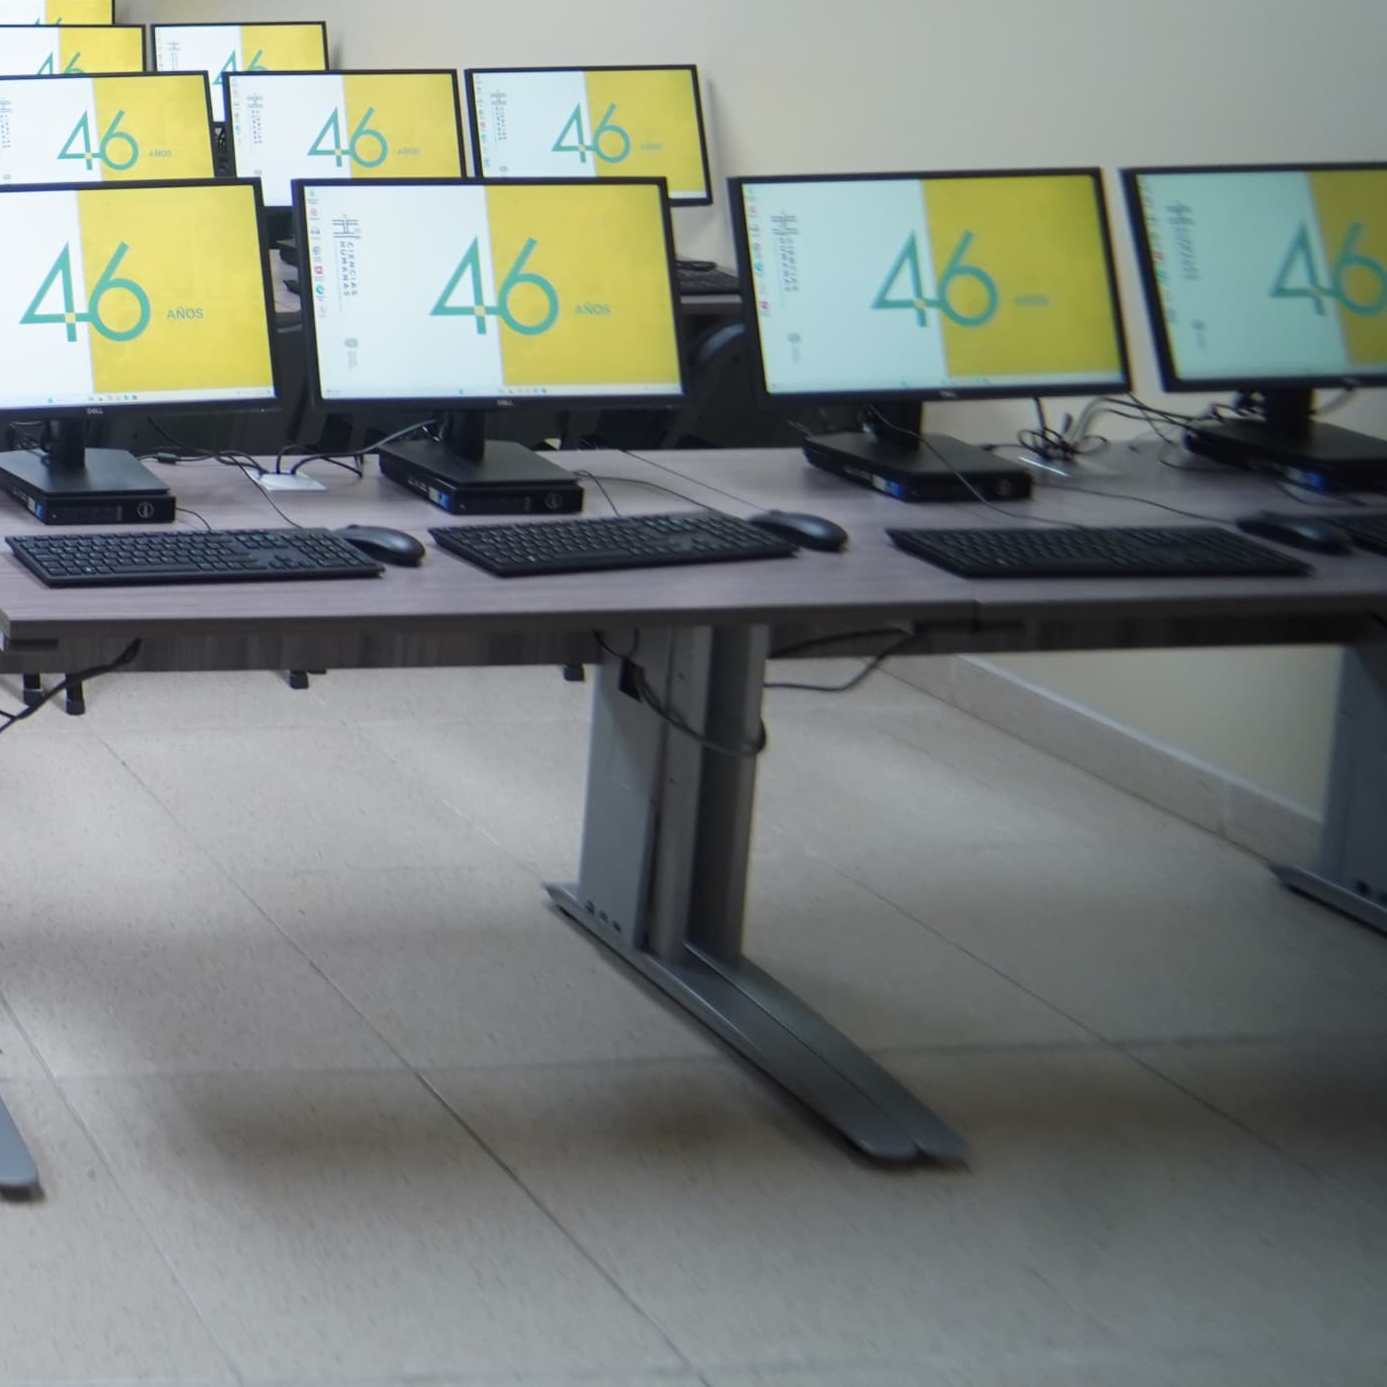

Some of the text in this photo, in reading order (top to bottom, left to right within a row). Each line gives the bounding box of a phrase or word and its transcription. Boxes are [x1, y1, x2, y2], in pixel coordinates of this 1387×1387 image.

[56, 110, 139, 171] 46
[306, 106, 389, 168] 46
[551, 102, 631, 163] 46
[19, 241, 151, 342] 46
[339, 241, 350, 297] HUMANAS
[347, 241, 358, 297] CIENCIAS
[429, 234, 560, 336] 46
[870, 228, 1000, 328] 46
[1270, 220, 1387, 317] 46
[166, 306, 204, 320] AÑOS
[575, 303, 611, 316] AÑOS
